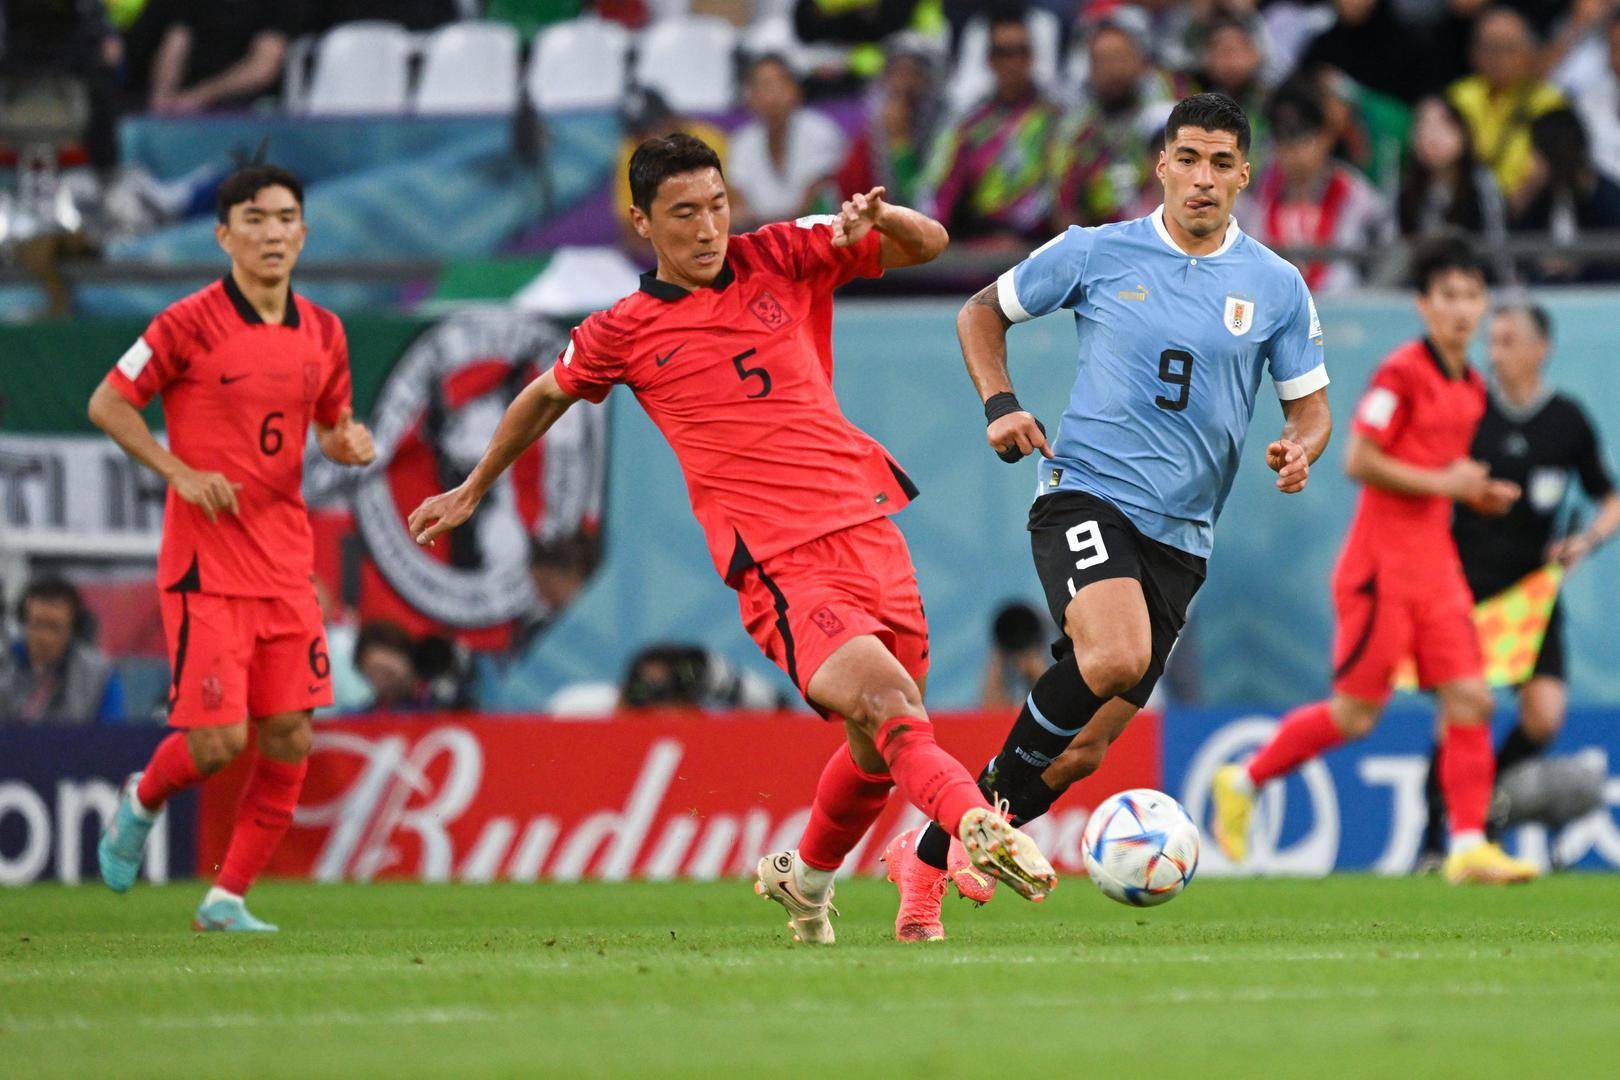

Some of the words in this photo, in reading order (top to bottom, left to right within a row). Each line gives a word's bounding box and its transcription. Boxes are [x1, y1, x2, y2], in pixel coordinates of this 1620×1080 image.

[731, 347, 772, 399] 5
[1154, 348, 1194, 412] 9
[259, 411, 284, 456] 6
[1065, 520, 1110, 570] 9
[308, 636, 330, 679] 6
